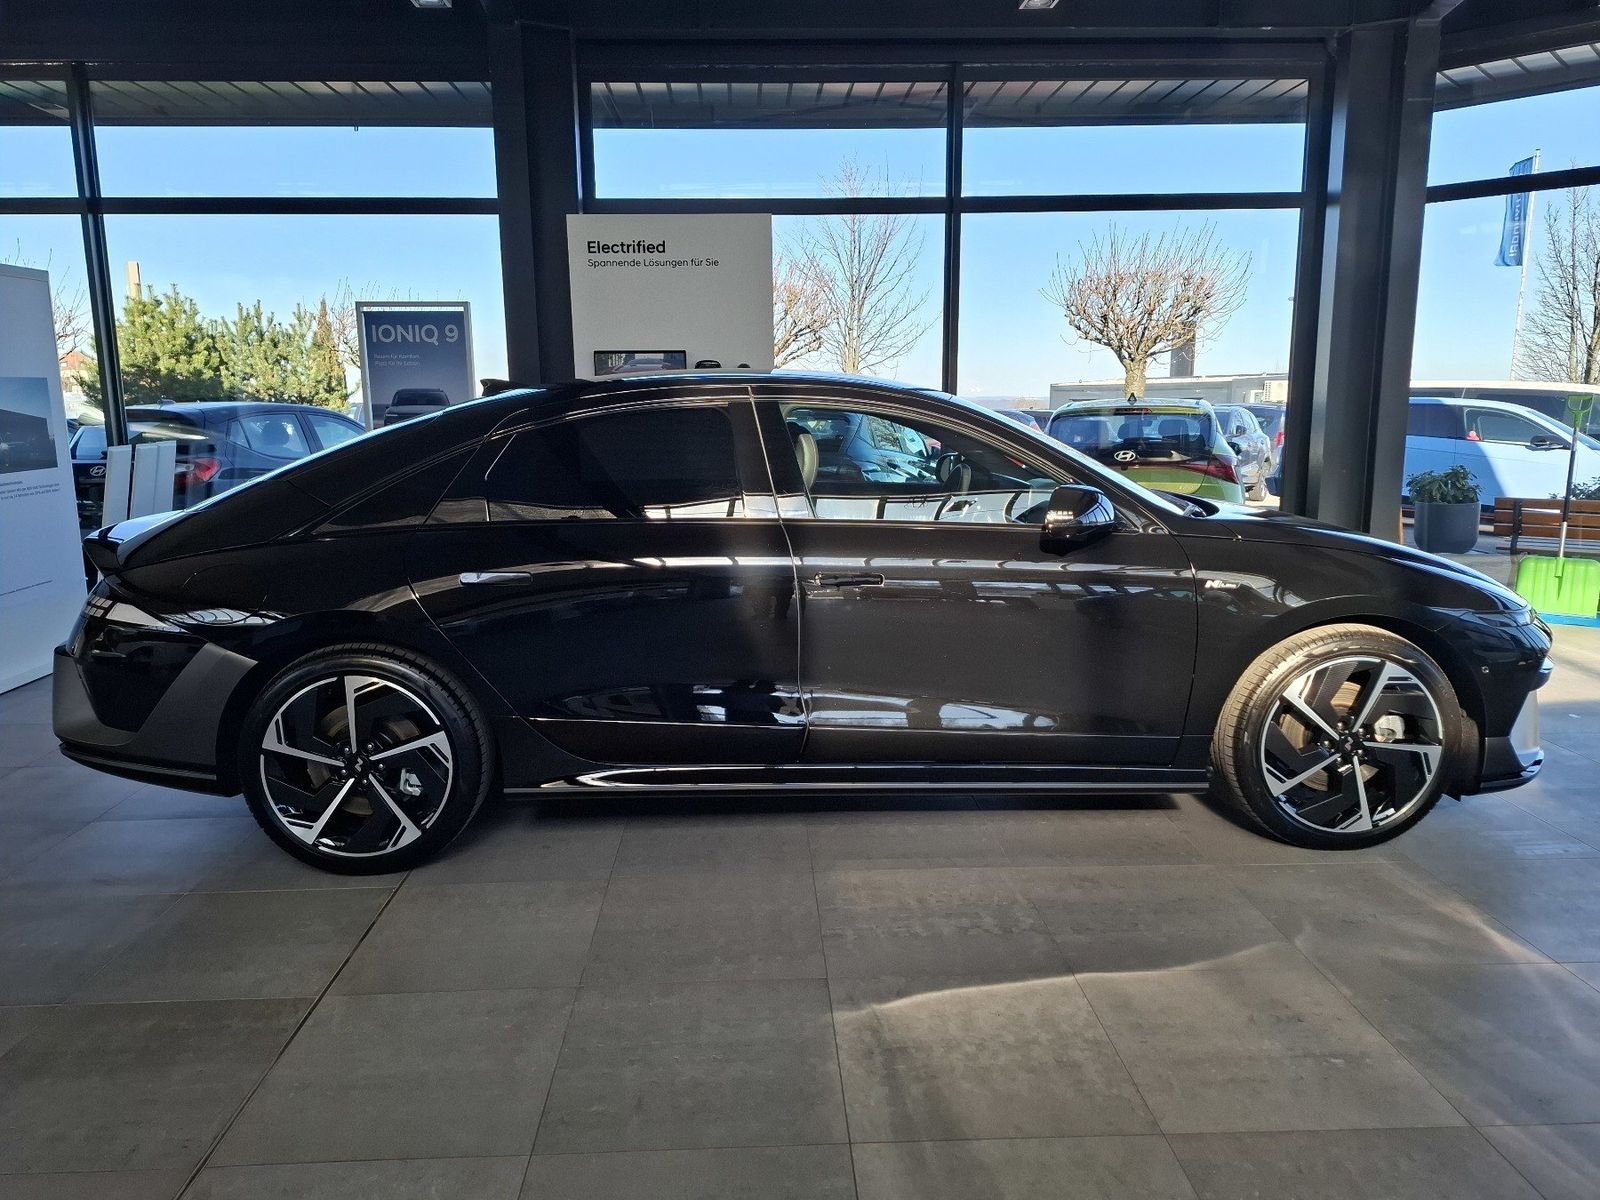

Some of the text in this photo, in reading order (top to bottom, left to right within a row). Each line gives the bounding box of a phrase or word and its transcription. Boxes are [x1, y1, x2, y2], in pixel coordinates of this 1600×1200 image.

[587, 240, 666, 254] Electrified
[587, 258, 720, 269] Spannende Lösungen für Sie
[371, 324, 459, 346] IONIQ 9
